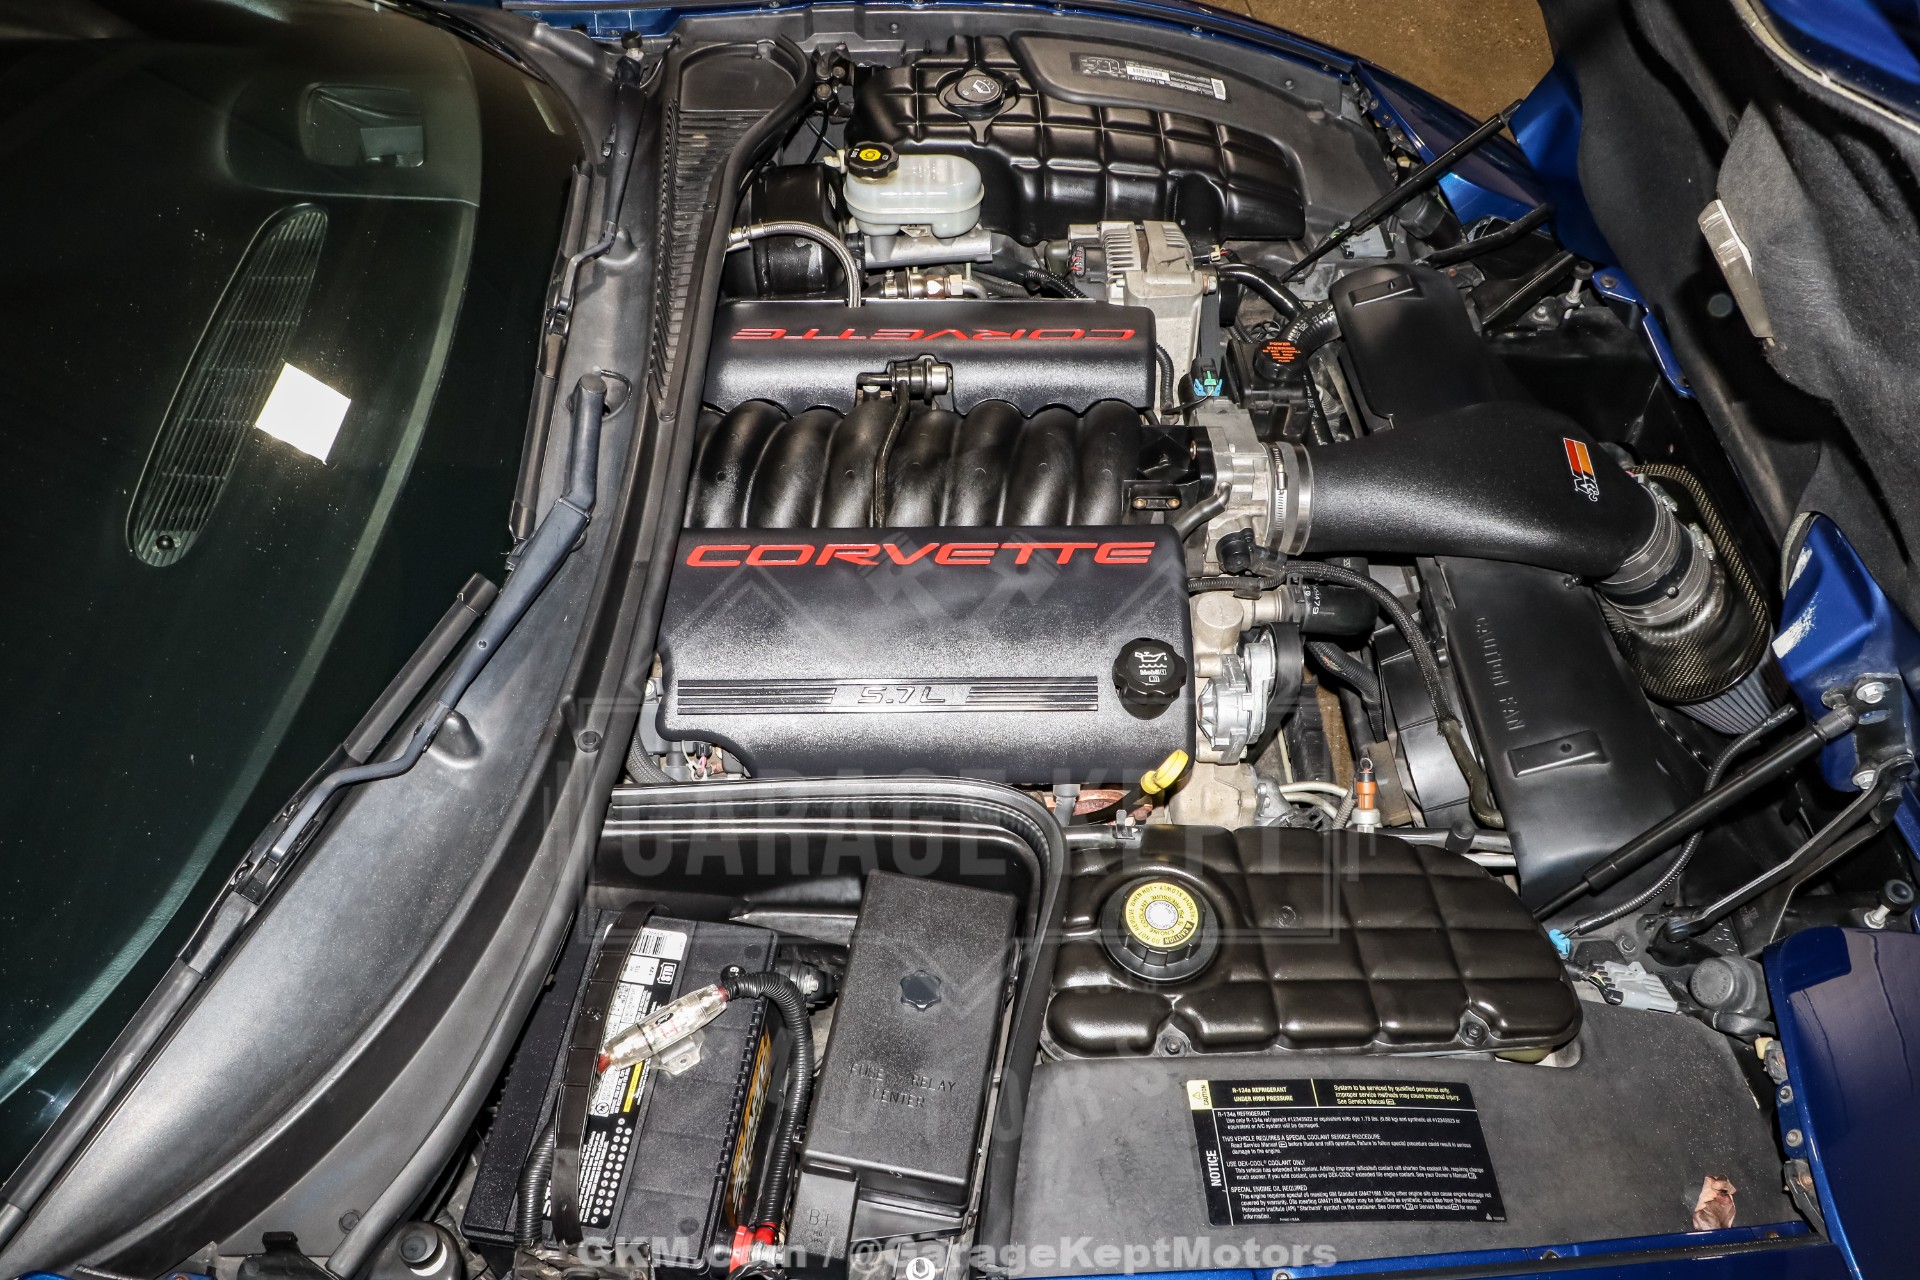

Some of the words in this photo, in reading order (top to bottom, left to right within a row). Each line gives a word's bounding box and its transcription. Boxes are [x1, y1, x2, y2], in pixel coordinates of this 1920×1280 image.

[731, 328, 1136, 341] CORVETTE
[686, 541, 1155, 566] CORVETTE
[858, 687, 946, 703] 5.7L
[1499, 696, 1526, 731] FAN
[1164, 929, 1189, 945] CAUTION
[849, 1063, 884, 1082] FUSE
[911, 1074, 957, 1093] RELAY
[872, 1088, 926, 1108] CENTER
[1205, 1149, 1222, 1187] NOTICE
